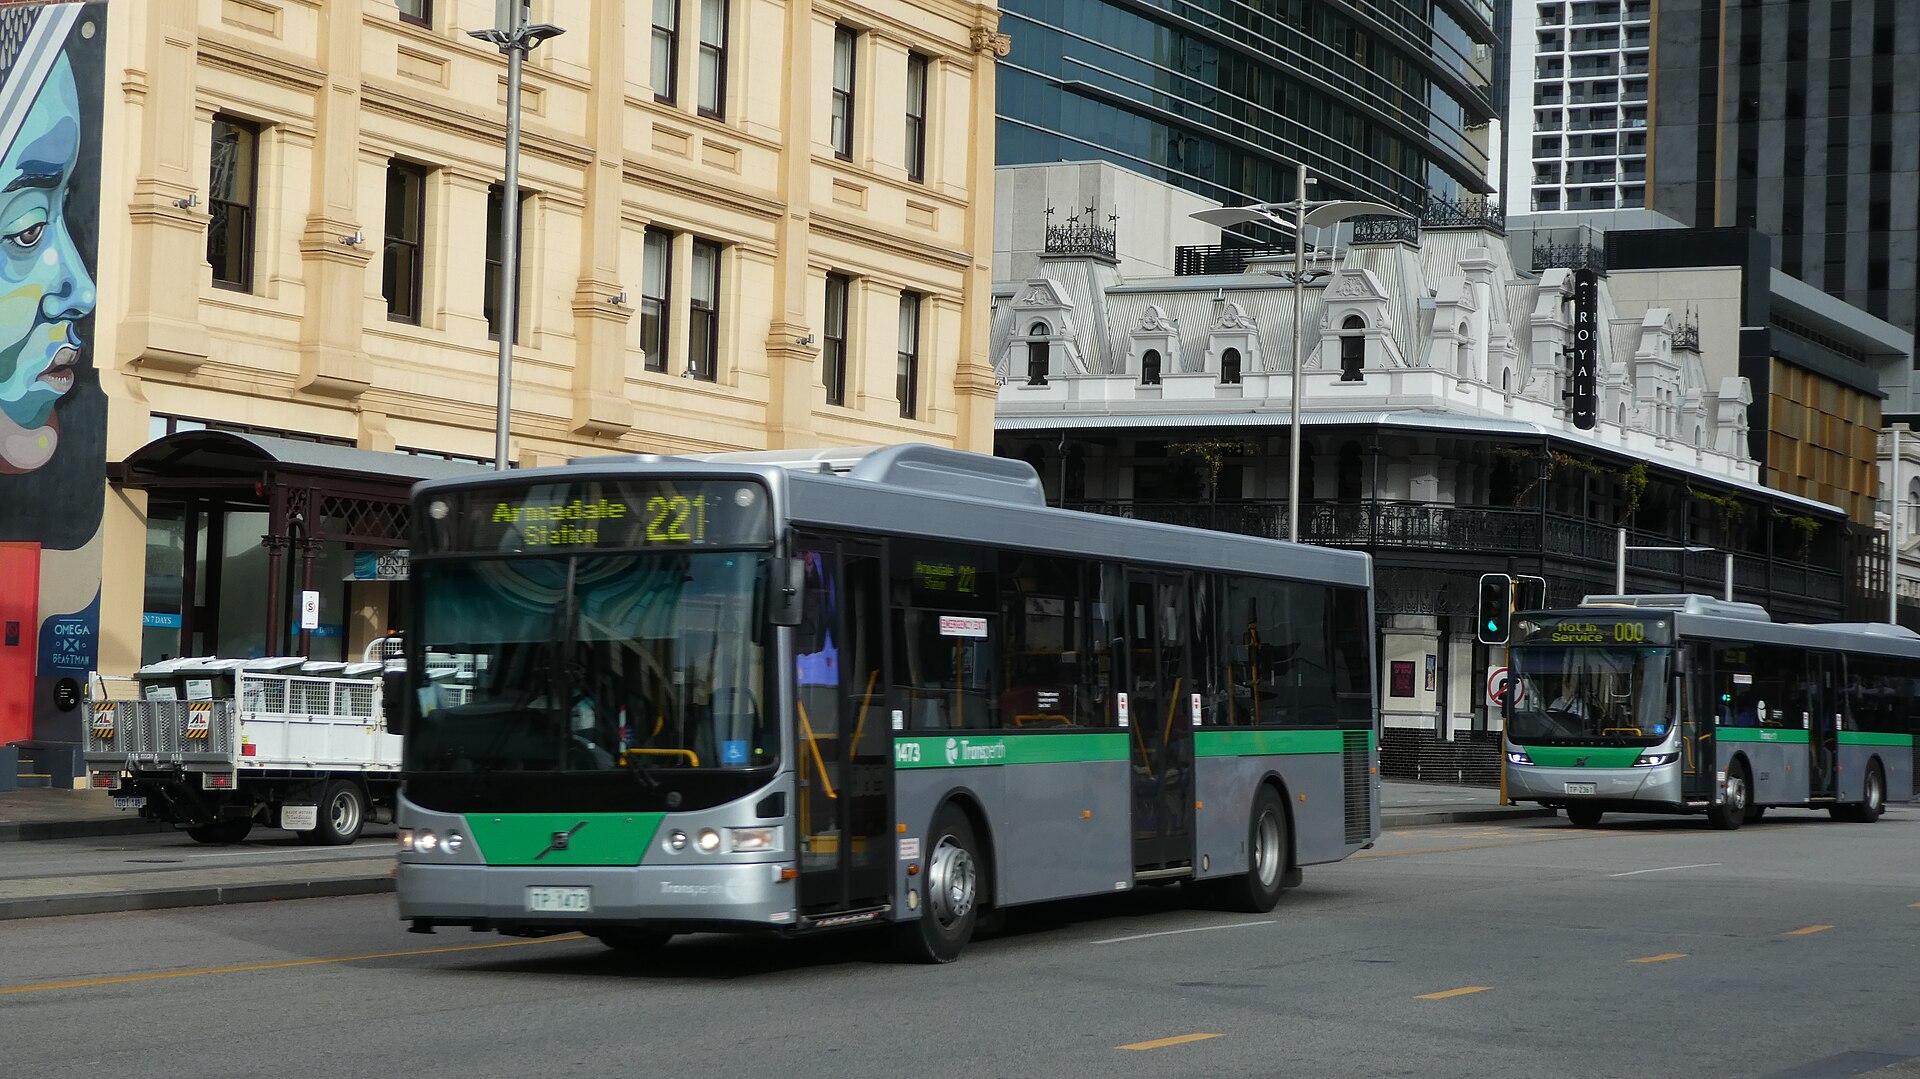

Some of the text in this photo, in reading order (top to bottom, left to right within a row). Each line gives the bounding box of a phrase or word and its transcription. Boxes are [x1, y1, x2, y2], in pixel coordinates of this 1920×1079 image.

[1577, 311, 1589, 396] ROYAL
[492, 499, 627, 522] Armadale
[646, 495, 705, 541] 221
[523, 524, 599, 545] Station
[377, 556, 410, 566] DENT
[377, 565, 410, 575] CENT
[155, 615, 172, 624] DAYS
[54, 624, 91, 635] OMEGA
[1558, 623, 1581, 632] Not
[1614, 622, 1645, 641] 000
[1552, 632, 1604, 642] Service
[52, 653, 90, 665] BEASTMAN
[895, 742, 921, 762] 1473
[960, 739, 1006, 764] Transperth
